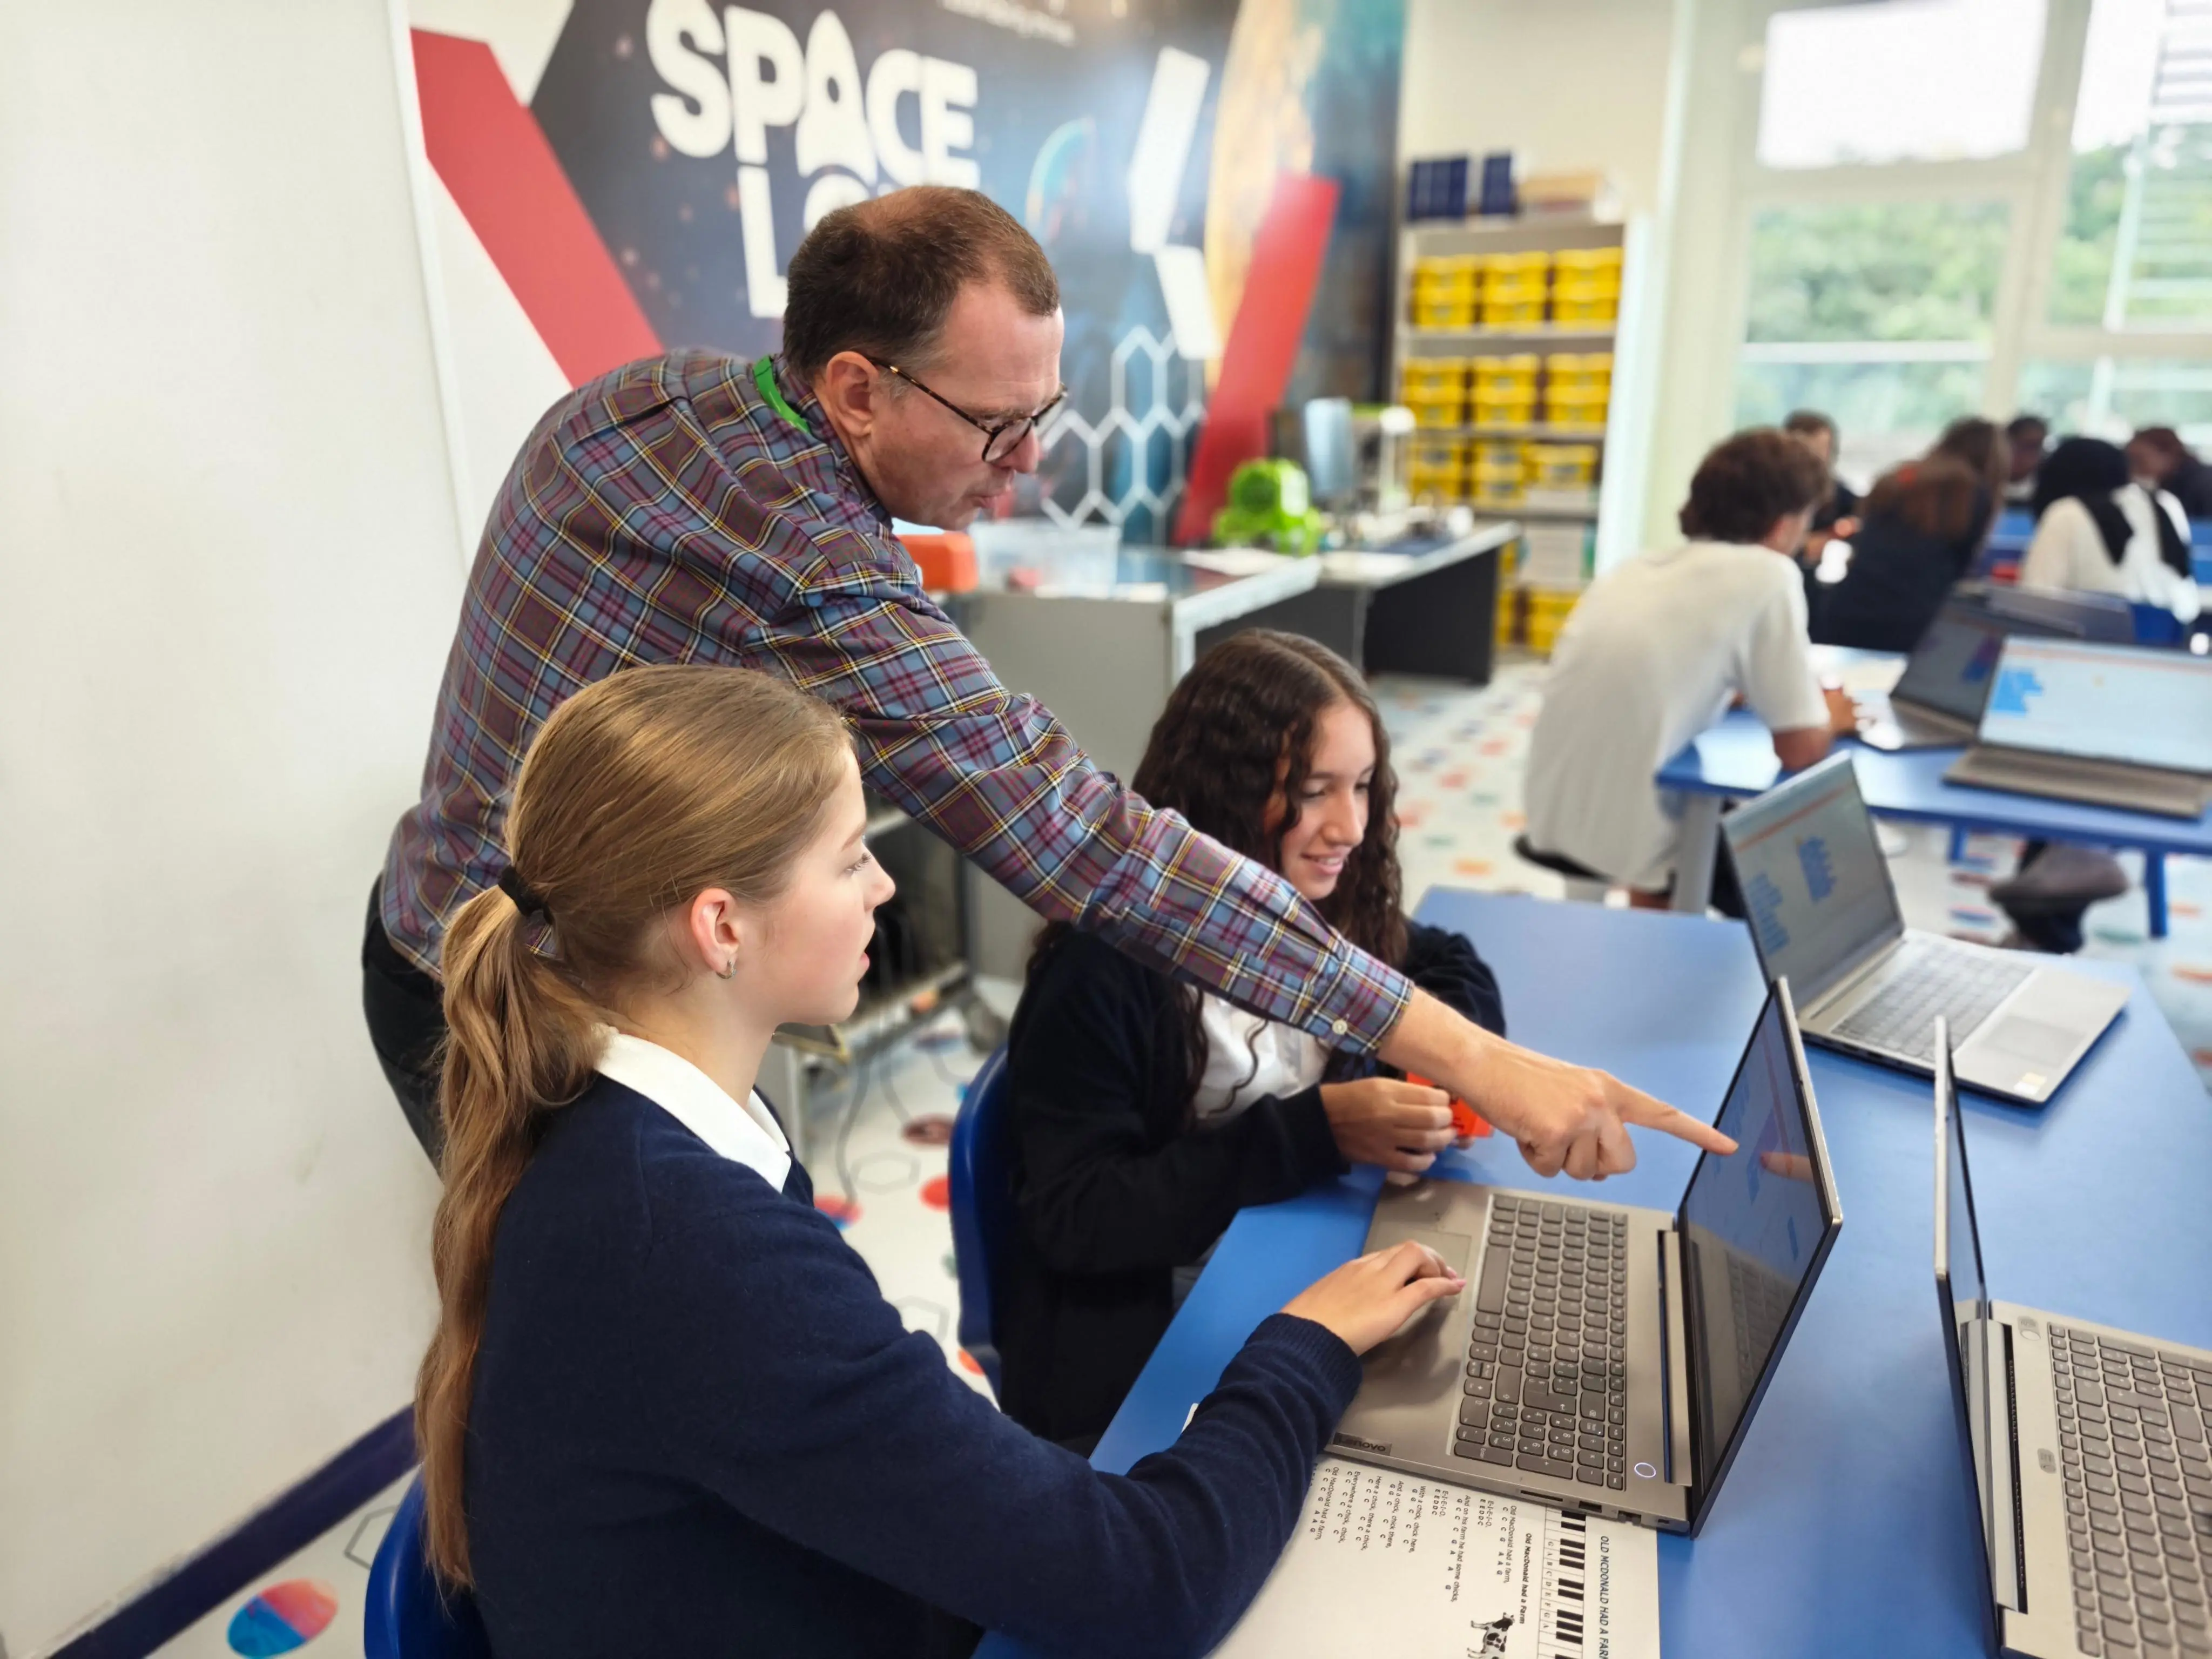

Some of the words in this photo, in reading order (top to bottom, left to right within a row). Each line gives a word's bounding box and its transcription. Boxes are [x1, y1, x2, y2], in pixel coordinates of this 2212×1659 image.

[646, 0, 981, 188] SPACE
[1331, 1466, 1339, 1476] Old
[1348, 1471, 1361, 1503] Everywhere
[1374, 1475, 1382, 1489] Here
[1324, 1476, 1337, 1507] MacDonald
[1368, 1495, 1378, 1510] chick,
[1392, 1498, 1400, 1513] chick,
[1320, 1507, 1329, 1519] had
[1342, 1509, 1351, 1525] chick,
[1413, 1504, 1422, 1520] chick,
[1366, 1513, 1374, 1528] there
[1389, 1515, 1397, 1529] chick
[1314, 1525, 1325, 1540] farm,
[1338, 1527, 1347, 1543] chick,
[1385, 1531, 1394, 1548] there,
[1507, 1516, 1515, 1548] MacDonald
[1360, 1534, 1370, 1550] chick,
[1408, 1538, 1417, 1553] here,
[1458, 1541, 1465, 1549] he
[1600, 1535, 1609, 1553] OLD
[1522, 1545, 1531, 1582] MacDonald
[1503, 1567, 1512, 1583] farm,
[1599, 1555, 1609, 1604] MCDONALD
[1450, 1581, 1460, 1602] chicks,
[1519, 1604, 1527, 1624] Farm
[1599, 1606, 1609, 1626] HAD
